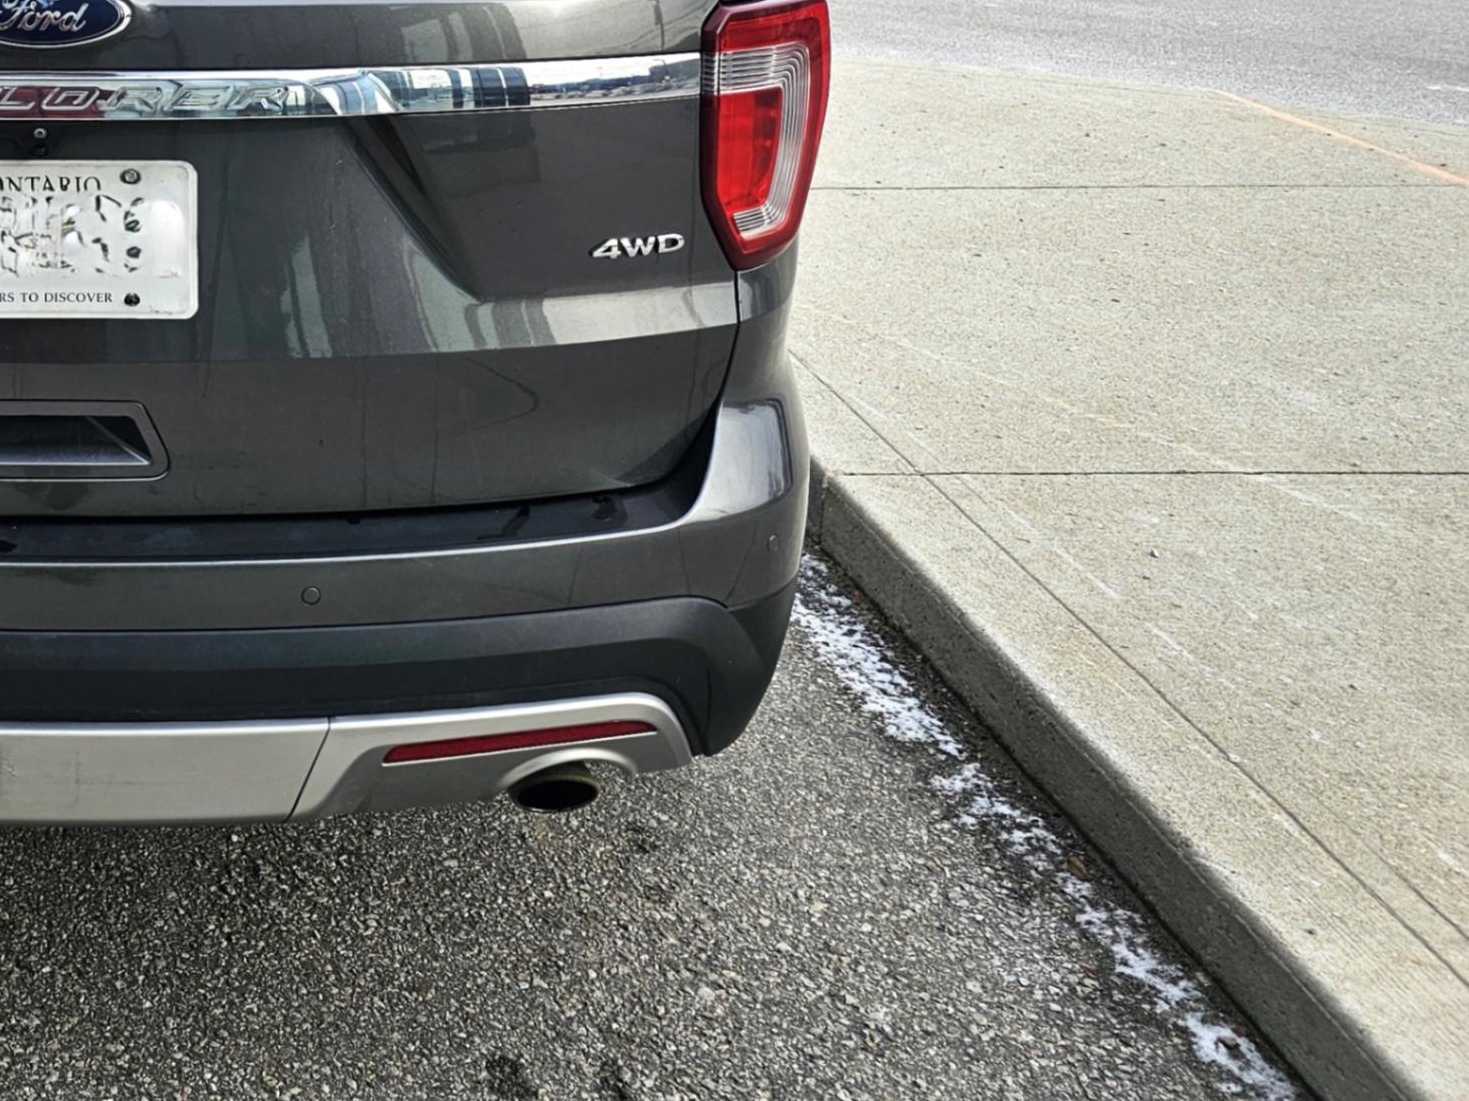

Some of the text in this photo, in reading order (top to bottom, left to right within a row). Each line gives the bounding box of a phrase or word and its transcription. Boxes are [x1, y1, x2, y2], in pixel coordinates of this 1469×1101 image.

[592, 233, 685, 259] 4WD
[20, 291, 39, 303] TO
[44, 291, 113, 303] DISCOVER
